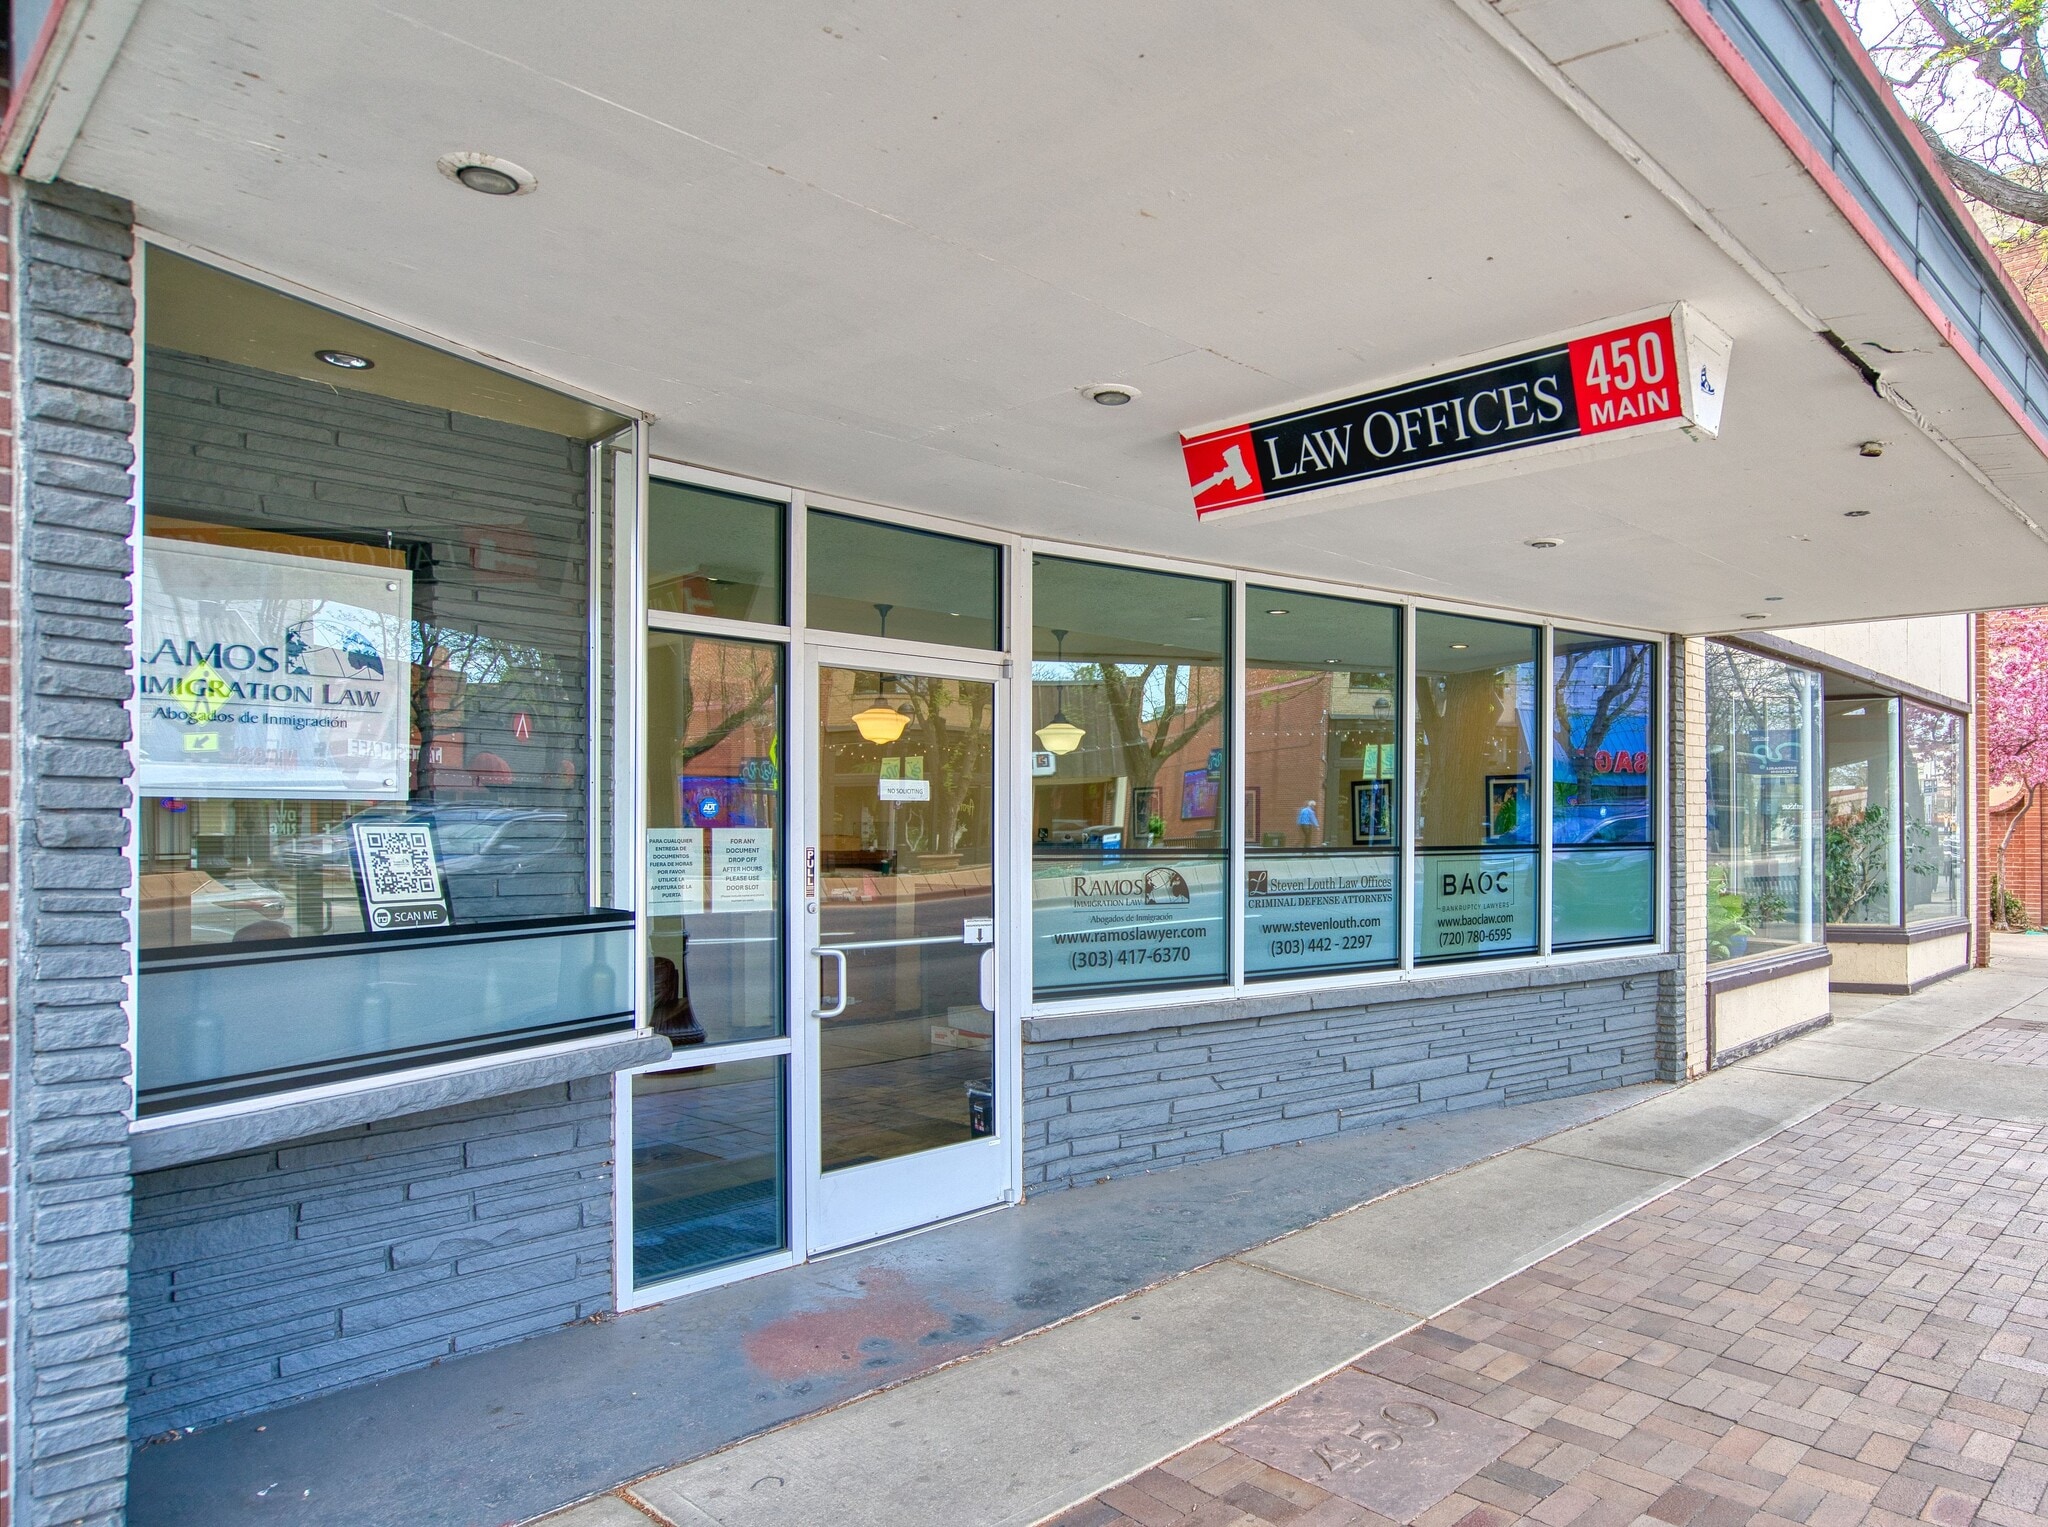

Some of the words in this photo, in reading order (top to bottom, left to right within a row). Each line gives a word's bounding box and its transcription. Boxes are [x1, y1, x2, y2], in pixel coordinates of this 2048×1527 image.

[1585, 331, 1665, 395] 450
[1589, 387, 1670, 426] MAIN
[1263, 424, 1353, 481] LAW
[1363, 375, 1564, 458] OFFICES
[141, 638, 280, 673] AMOS
[141, 675, 313, 702] MIGRATION
[322, 684, 381, 707] LAW
[152, 706, 235, 726] Abogados
[237, 712, 259, 725] de
[262, 713, 348, 731] Inmigración
[703, 803, 717, 811] ADT
[806, 851, 815, 886] PULL
[1074, 876, 1143, 897] RAMOS
[1270, 878, 1304, 892] Steven
[1307, 877, 1338, 890] Louth
[1339, 876, 1358, 889] Law
[1360, 875, 1391, 888] Offices
[1443, 871, 1509, 896] BAOC
[1073, 899, 1124, 908] IMMIGRATION
[1125, 897, 1143, 906] LAW
[1248, 898, 1297, 909] CRIMINAL
[1298, 896, 1340, 906] DEFENSE
[1341, 893, 1393, 904] ATTORNEYS
[1441, 903, 1481, 912] BANKRUPTCY
[394, 911, 421, 922] SCAN
[423, 910, 438, 920] ME
[1090, 914, 1124, 925] Abogados
[1125, 914, 1135, 922] de
[1136, 913, 1173, 923] Inmigración
[1262, 916, 1381, 934] www.stevenlouth.com
[1437, 913, 1514, 927] www.baoclaw.com
[1053, 926, 1207, 945] www.ramoslawyer.com
[1439, 931, 1465, 948] (720)
[1467, 928, 1512, 943] 780-6595
[1271, 938, 1305, 958] (303)
[1308, 937, 1332, 953] 442
[1342, 934, 1373, 949] 2297
[1071, 950, 1113, 971] (303)
[1117, 946, 1191, 966] 417-6370
